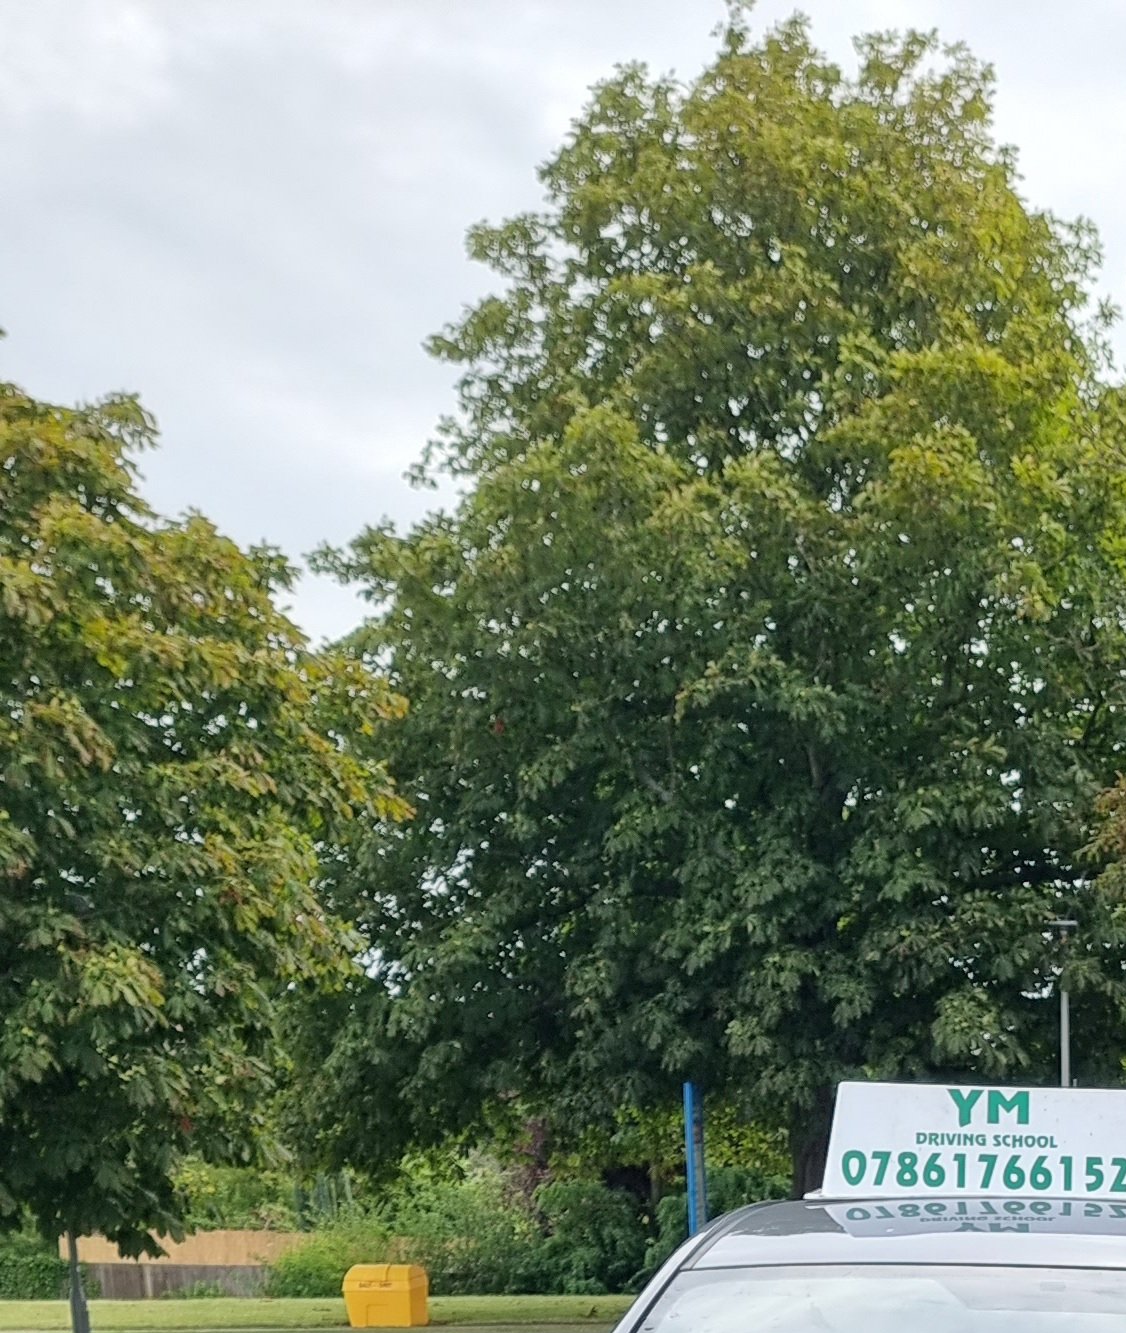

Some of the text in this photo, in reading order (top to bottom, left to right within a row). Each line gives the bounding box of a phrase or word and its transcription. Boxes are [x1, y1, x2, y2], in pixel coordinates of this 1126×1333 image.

[947, 1088, 1030, 1127] YM
[915, 1131, 1058, 1149] DRIVING SCHOOL
